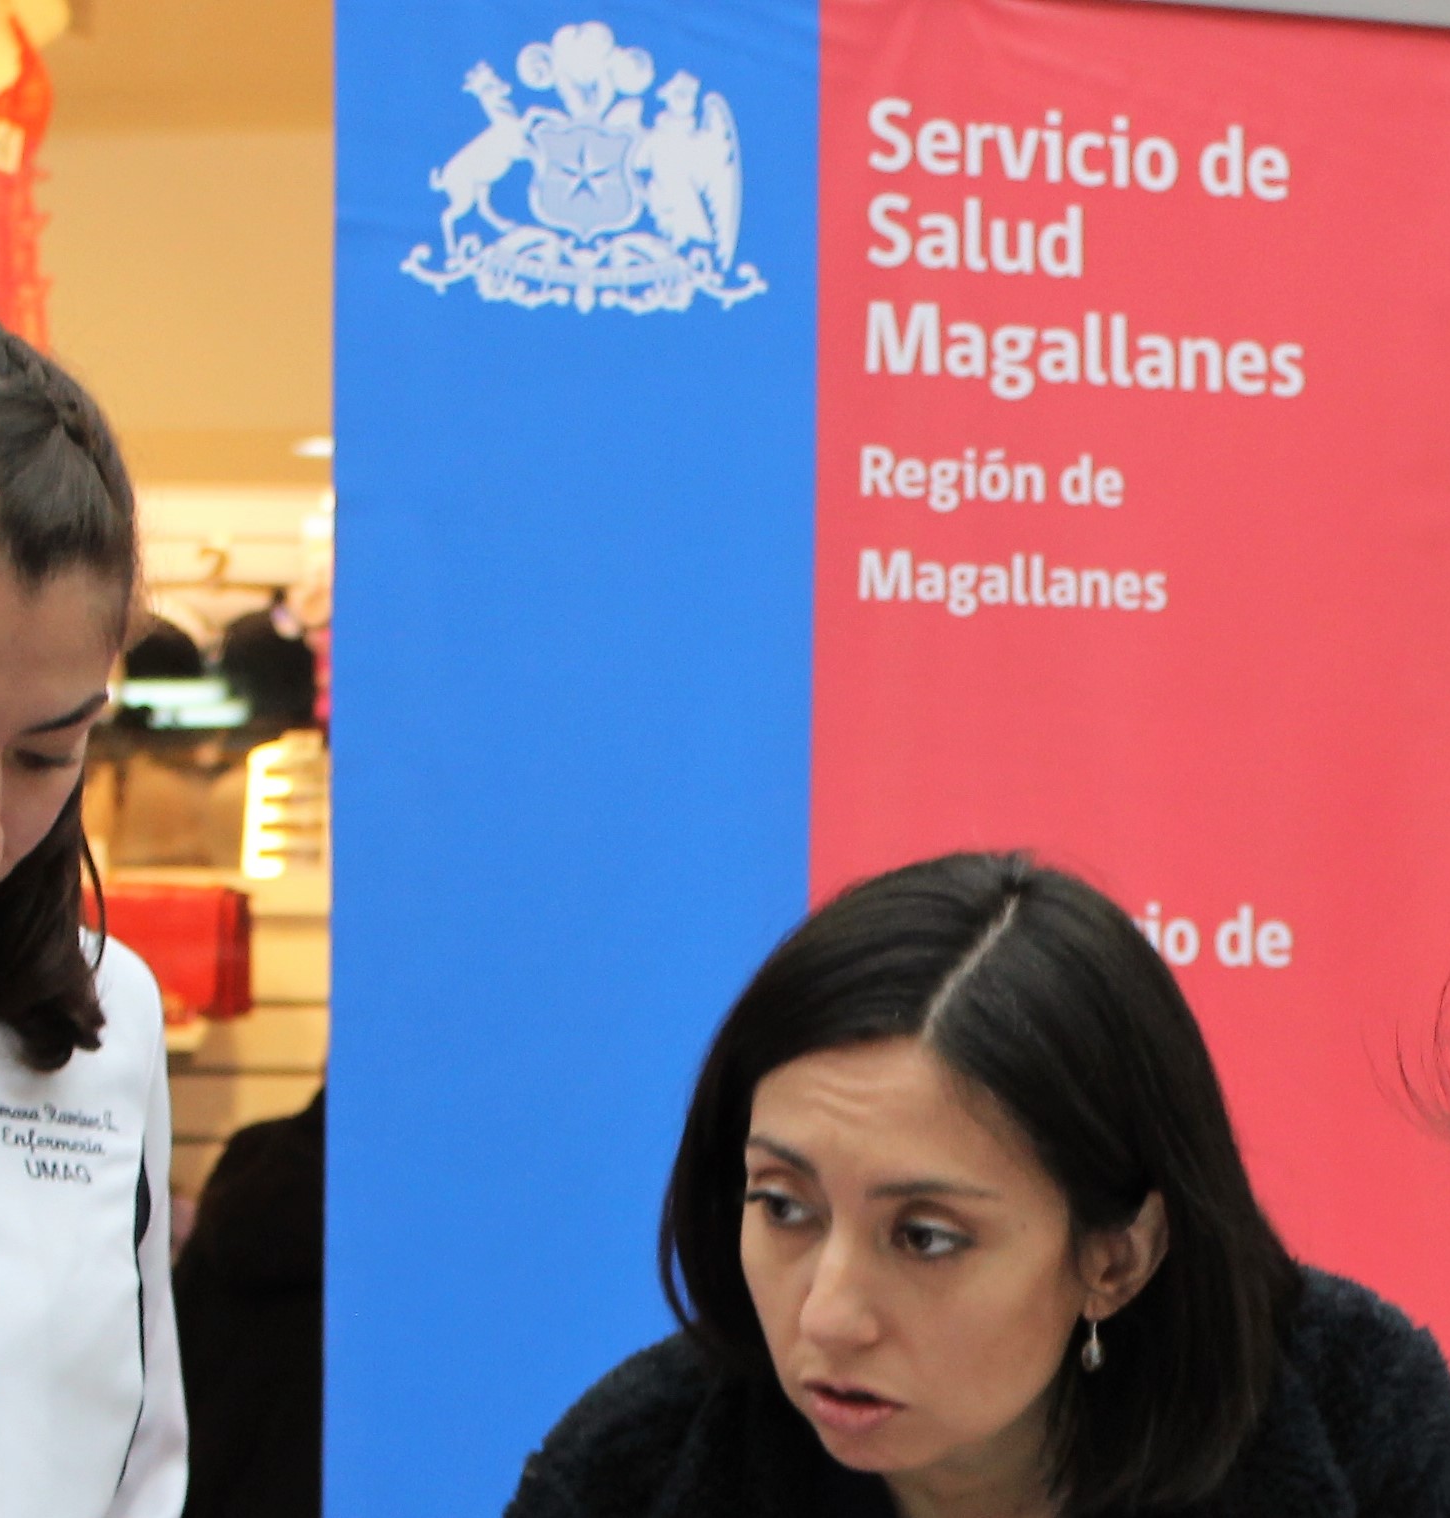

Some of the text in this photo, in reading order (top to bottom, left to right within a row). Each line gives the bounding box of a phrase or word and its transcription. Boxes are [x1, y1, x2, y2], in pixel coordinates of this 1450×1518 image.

[866, 96, 1291, 202] Servicio de
[866, 192, 1085, 278] Salud
[863, 299, 1307, 402] Magallanes
[858, 443, 1126, 514] Región de
[857, 547, 1169, 618] Magallanes
[1214, 903, 1294, 969] de
